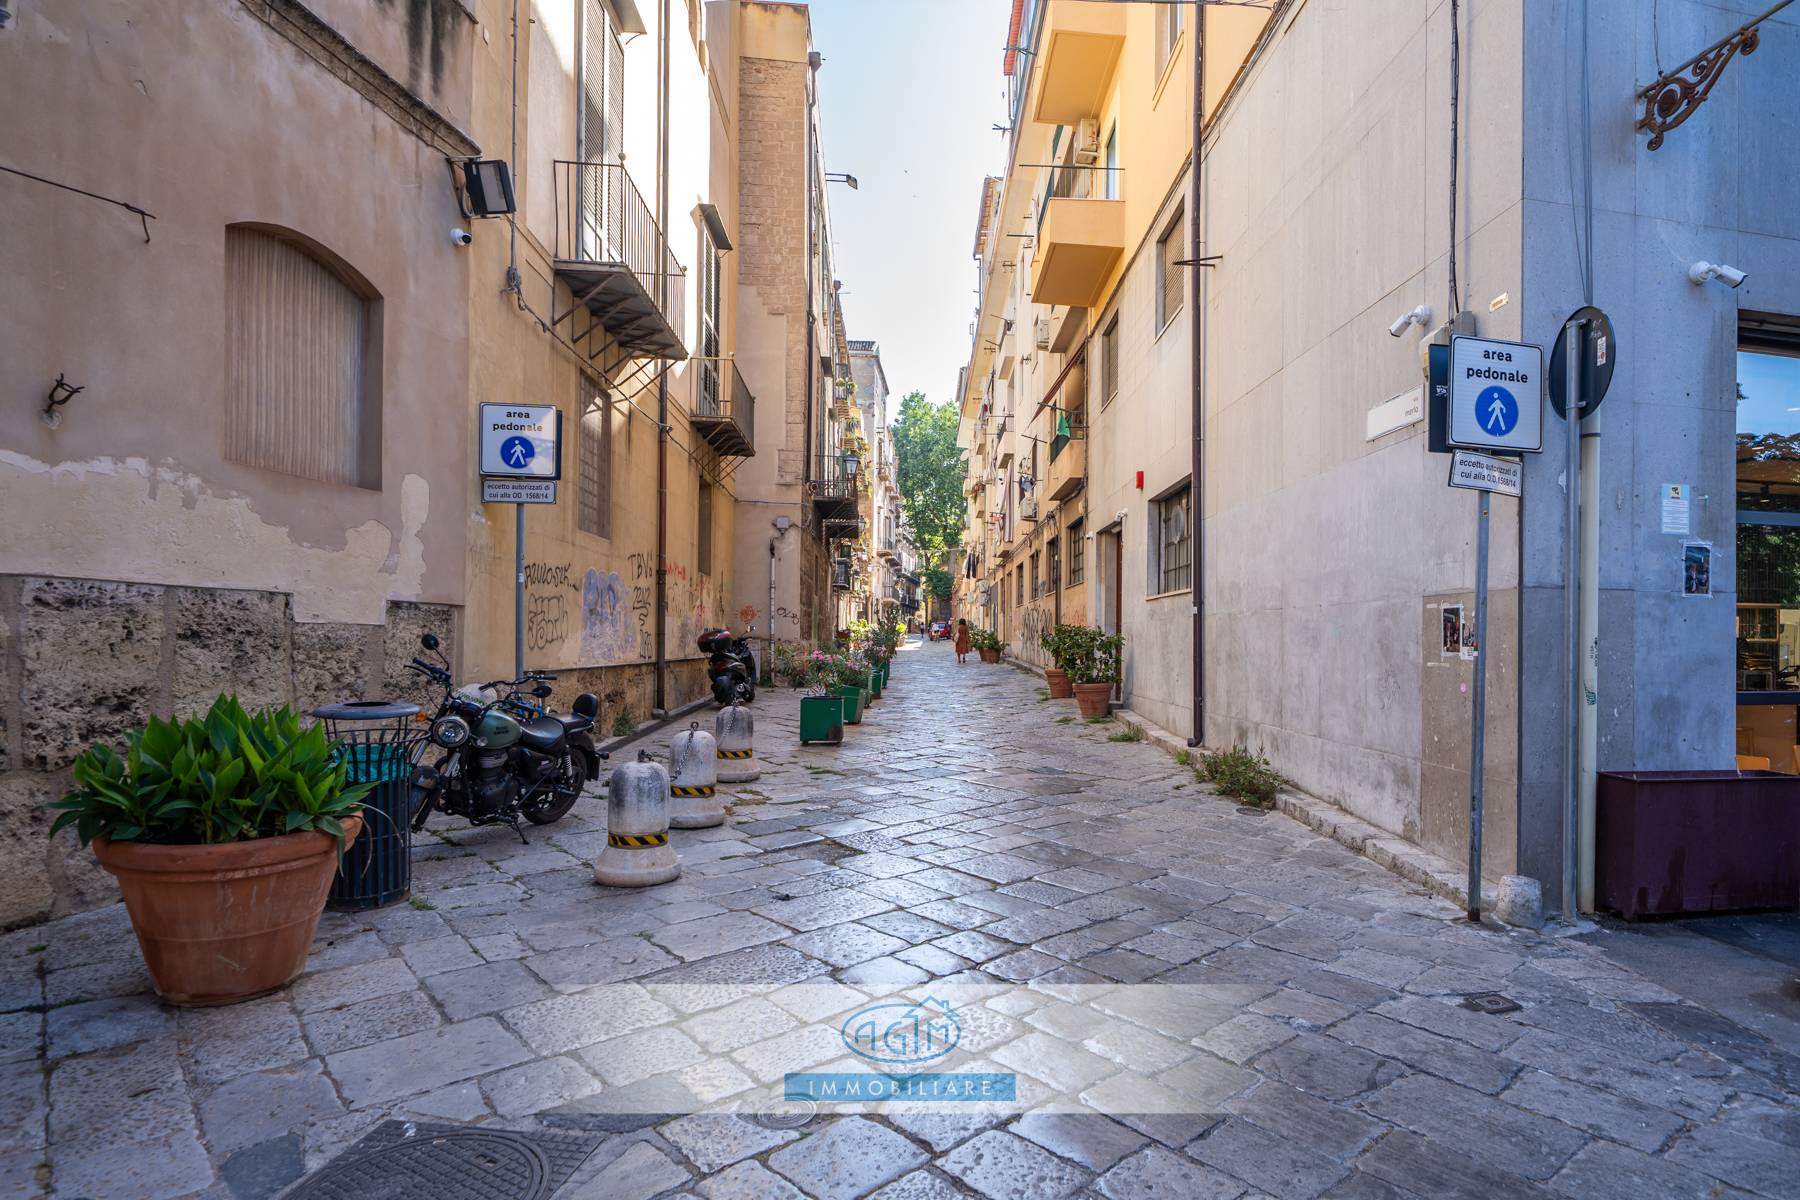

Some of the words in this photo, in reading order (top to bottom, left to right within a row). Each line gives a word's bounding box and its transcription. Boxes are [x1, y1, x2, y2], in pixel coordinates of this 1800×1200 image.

[1483, 350, 1513, 362] area
[1466, 366, 1529, 383] pedonale
[505, 411, 530, 419] area
[492, 422, 544, 432] pedonale
[1459, 459, 1485, 469] eccetto
[1485, 463, 1512, 476] autorizzati
[1512, 468, 1518, 477] di
[1460, 471, 1472, 479] cui
[1473, 472, 1486, 480] alla
[511, 483, 543, 491] autorizzati
